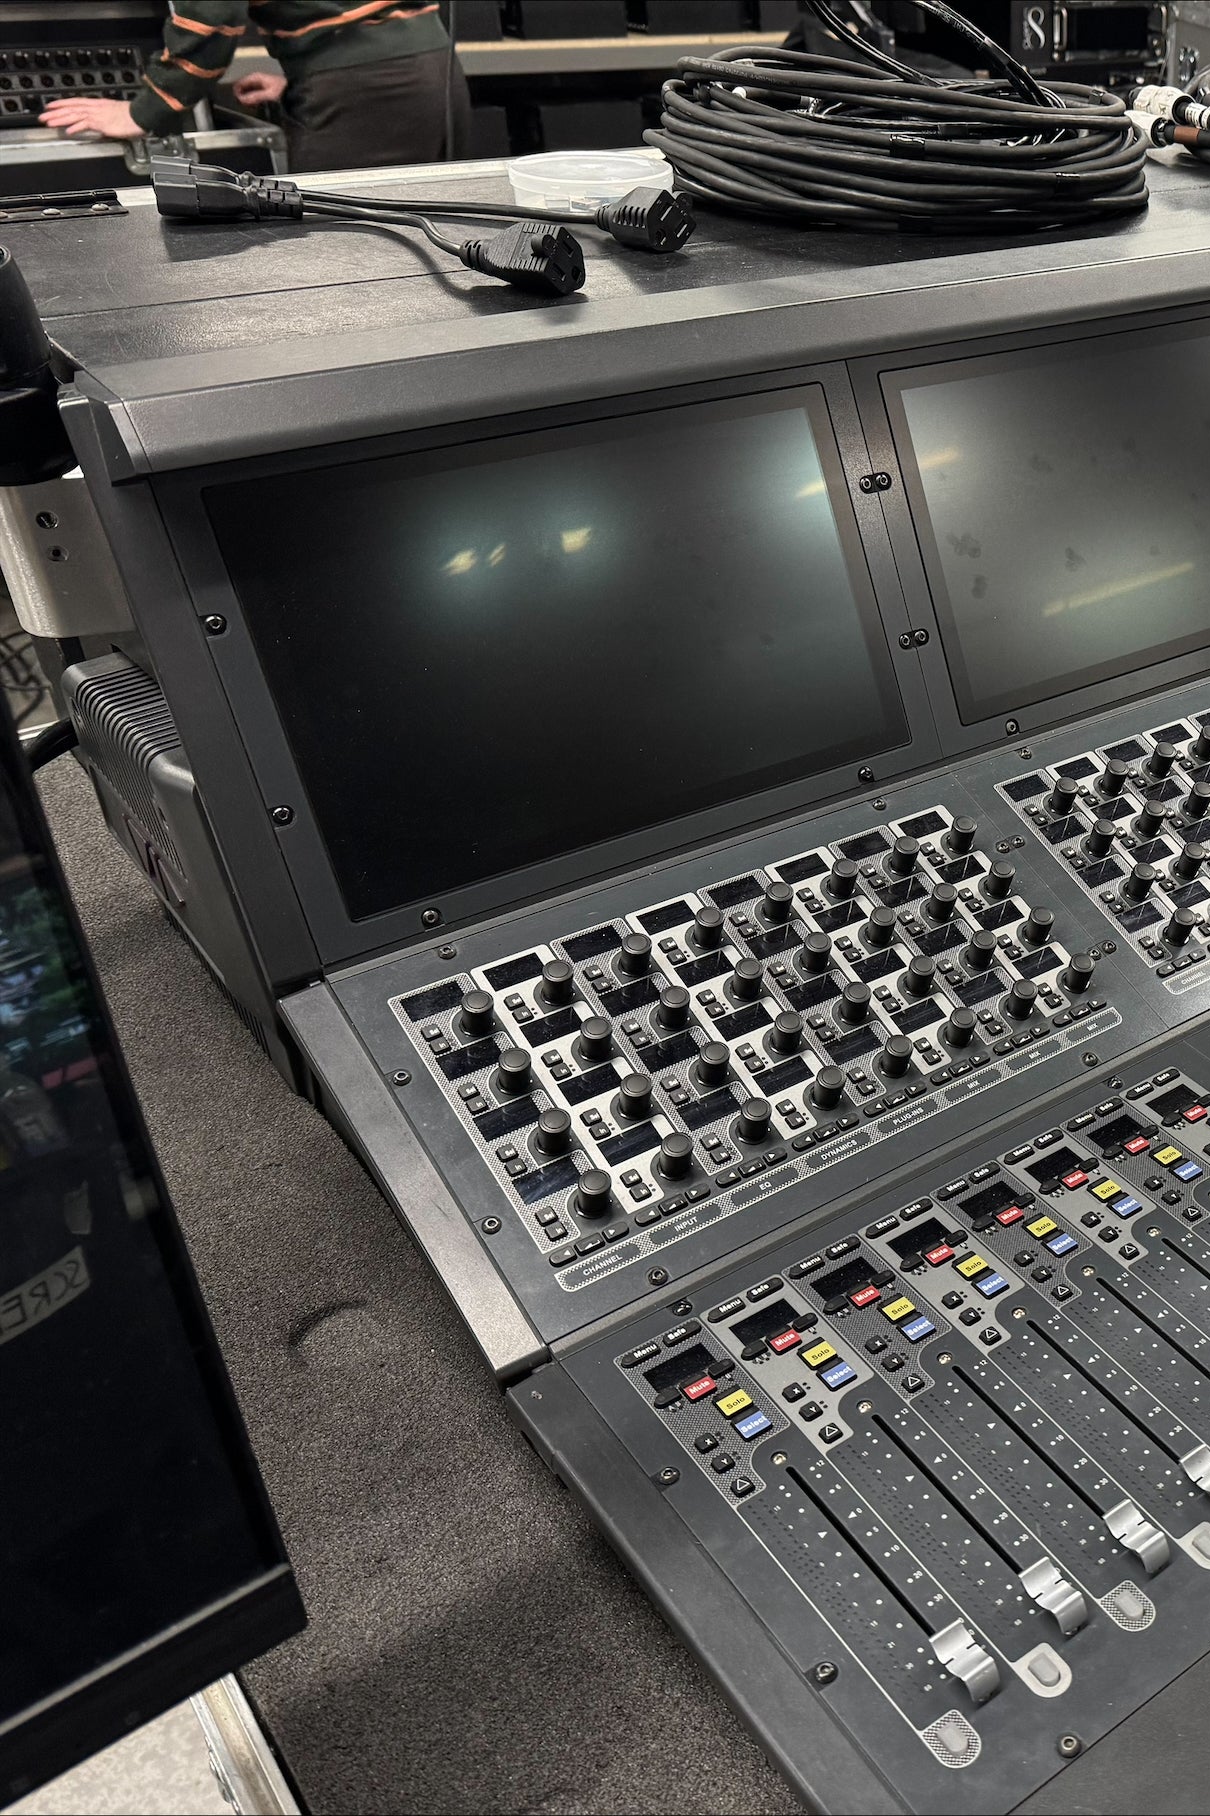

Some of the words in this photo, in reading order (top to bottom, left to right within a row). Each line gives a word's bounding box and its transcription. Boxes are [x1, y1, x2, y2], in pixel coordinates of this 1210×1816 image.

[1028, 1051, 1041, 1060] MIX
[967, 1079, 980, 1089] MIX
[892, 1107, 924, 1126] PLUG-INS
[1075, 1113, 1093, 1124] Menu
[820, 1139, 858, 1160] DYNAMICS
[1013, 1145, 1031, 1157] Menu
[1162, 1150, 1176, 1160] Solo
[1067, 1172, 1083, 1184] Mute
[759, 1181, 772, 1191] EQ
[947, 1179, 966, 1192] Menu
[1100, 1184, 1115, 1194] Solo
[904, 1202, 921, 1214] Safe
[1118, 1198, 1137, 1212] Select
[1001, 1209, 1018, 1221] Mute
[674, 1217, 698, 1232] INPUT
[876, 1216, 896, 1229] Menu
[1036, 1221, 1051, 1232] Solo
[830, 1242, 848, 1253] Safe
[1051, 1236, 1074, 1250] Select
[930, 1247, 949, 1260] Mute
[583, 1254, 622, 1276] CHANNEL
[800, 1256, 821, 1270] Menu
[965, 1260, 982, 1272] Solo
[981, 1276, 1005, 1290] Select
[751, 1284, 770, 1296] Safe
[856, 1288, 875, 1302] Mute
[719, 1299, 741, 1314] Menu
[891, 1303, 909, 1315] Solo
[667, 1327, 686, 1341] Safe
[907, 1320, 932, 1336] Select
[775, 1333, 796, 1347] Mute
[633, 1343, 658, 1359] Menu
[812, 1348, 830, 1361] Solo
[827, 1366, 852, 1382] Select
[688, 1380, 711, 1395] Mute
[726, 1396, 746, 1410] Solo
[740, 1415, 767, 1434] Select
[1056, 1434, 1064, 1442] 10
[816, 1459, 825, 1467] 12
[999, 1512, 1008, 1520] 20
[891, 1544, 900, 1552] 10
[913, 1570, 923, 1579] 20
[934, 1593, 944, 1602] 30
